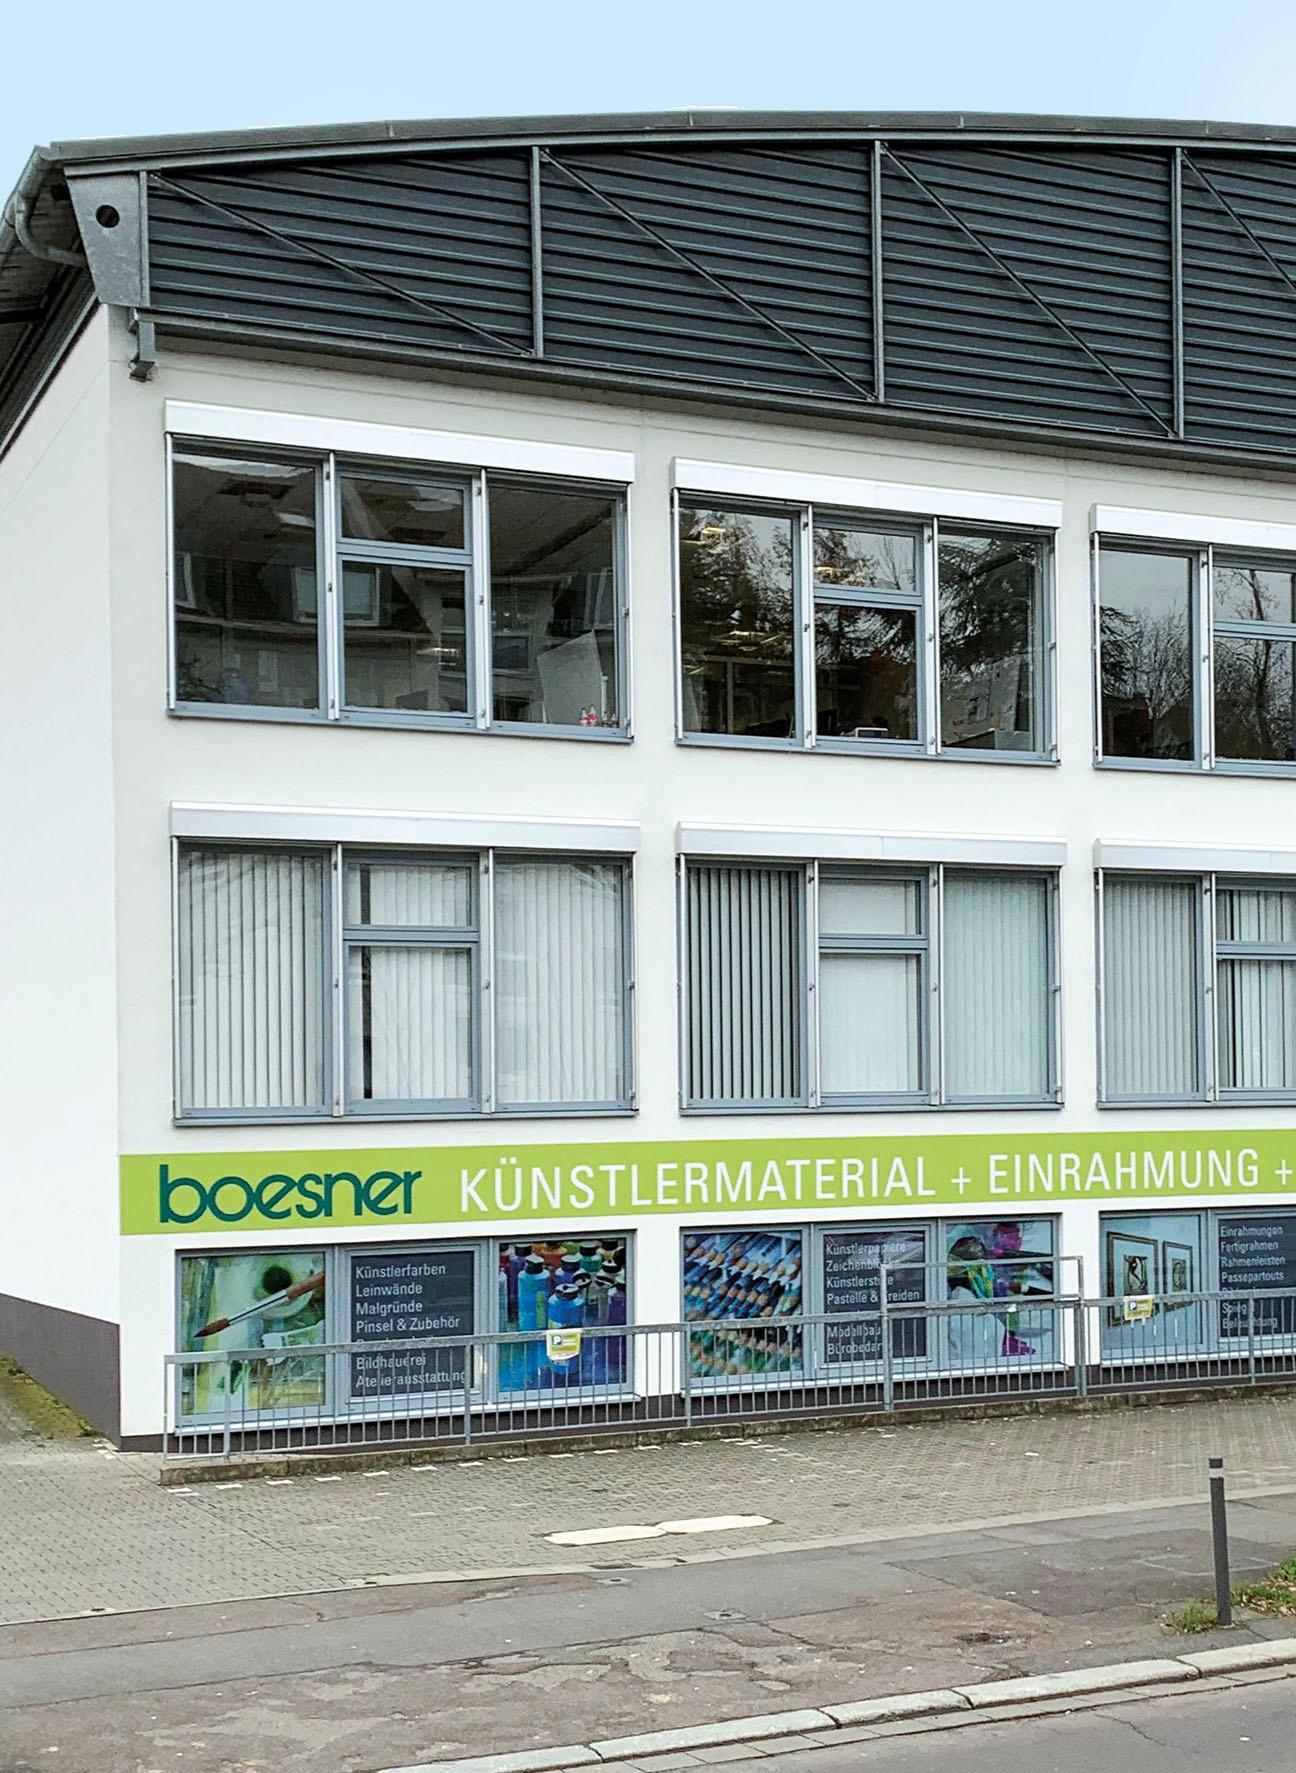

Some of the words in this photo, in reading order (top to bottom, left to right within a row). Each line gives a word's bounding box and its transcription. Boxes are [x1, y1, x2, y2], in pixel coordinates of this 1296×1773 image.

[159, 1163, 422, 1224] boesner
[460, 1155, 936, 1213] KÜNSTLERMATERIAL
[951, 1166, 972, 1195] +
[988, 1148, 1260, 1195] EINRAHMUNG
[1275, 1159, 1294, 1186] +
[1220, 1226, 1283, 1238] Einrahmungen
[1221, 1241, 1279, 1254] Fertigrahmen
[1221, 1256, 1286, 1268] Rahmenleisten
[355, 1263, 446, 1279] Künstlerfarben
[1221, 1272, 1285, 1283] Passepartouts
[355, 1281, 423, 1297] Leinwände
[827, 1292, 868, 1305] Pastelle
[870, 1290, 879, 1303] &
[886, 1290, 920, 1302] reiden
[355, 1300, 423, 1316] Malgründe
[356, 1319, 394, 1333] Pinsel
[396, 1318, 406, 1331] &
[409, 1315, 460, 1331] Zubehör
[827, 1341, 883, 1356] Bürobedar
[355, 1352, 426, 1370] Bildhauerei
[355, 1371, 467, 1389] Ateierausstattung
